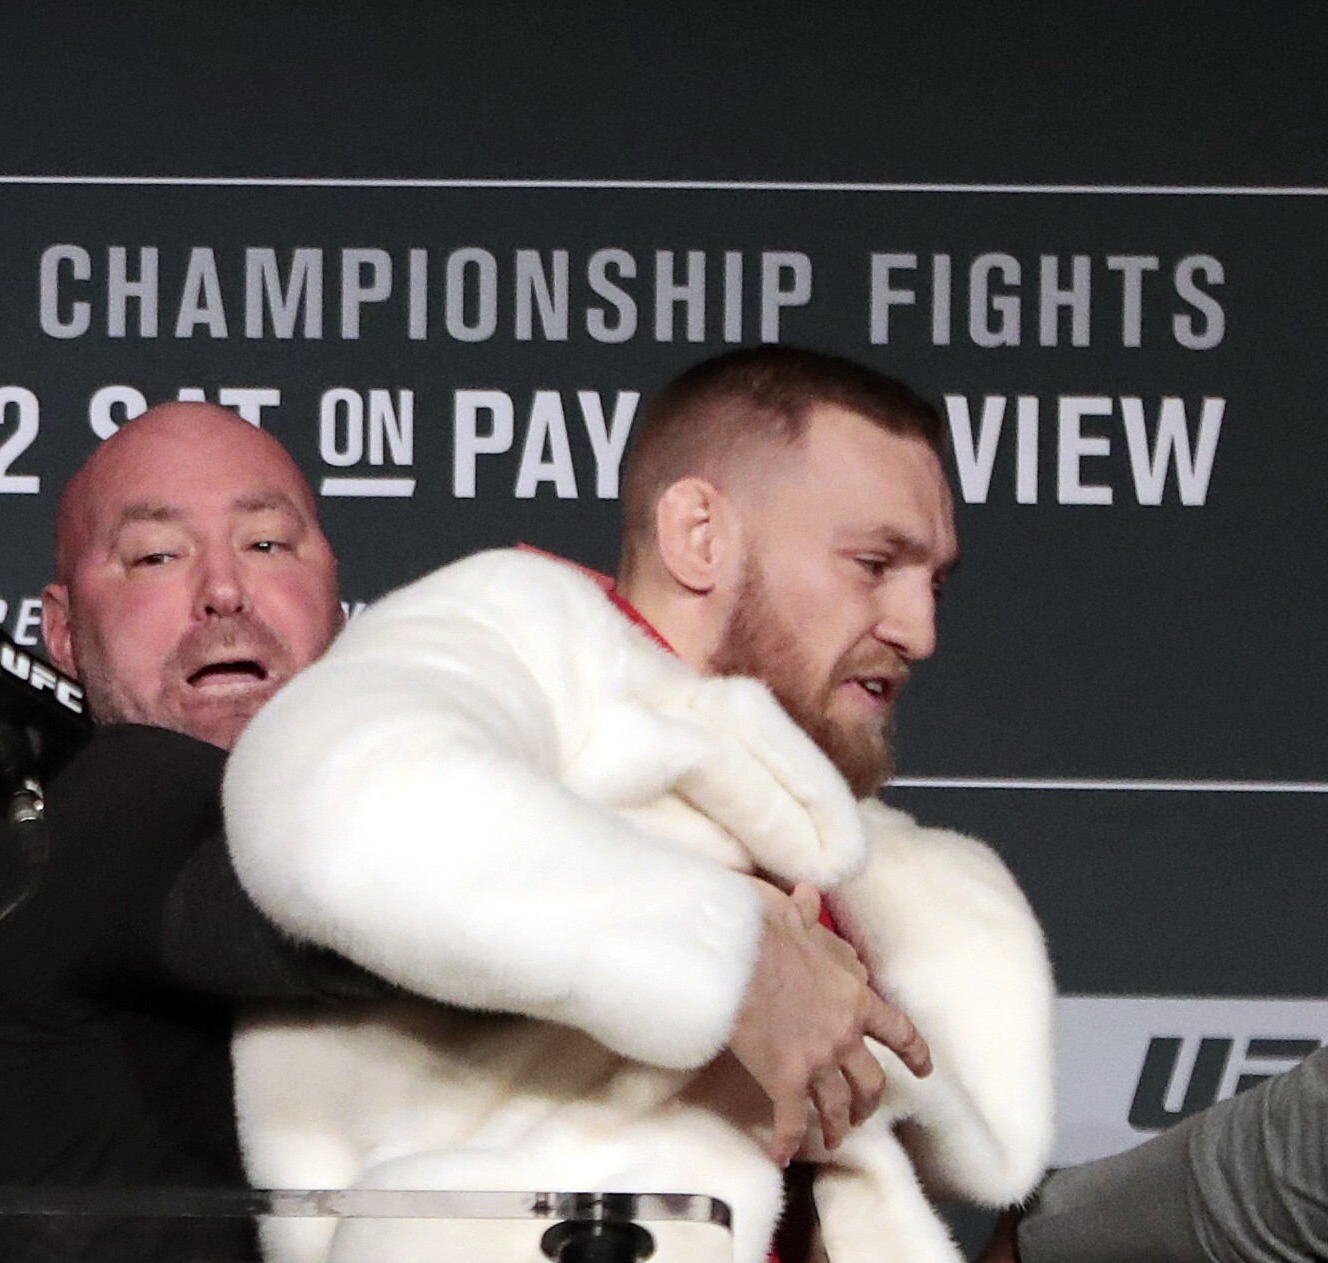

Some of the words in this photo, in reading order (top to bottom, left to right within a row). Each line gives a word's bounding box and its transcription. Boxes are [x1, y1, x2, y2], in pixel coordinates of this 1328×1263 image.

[40, 244, 813, 343] CHAMPIONSHIP
[870, 251, 1226, 350] FIGHTS
[319, 387, 416, 470] ON
[453, 390, 640, 499] PAY
[945, 395, 1225, 506] VIEW
